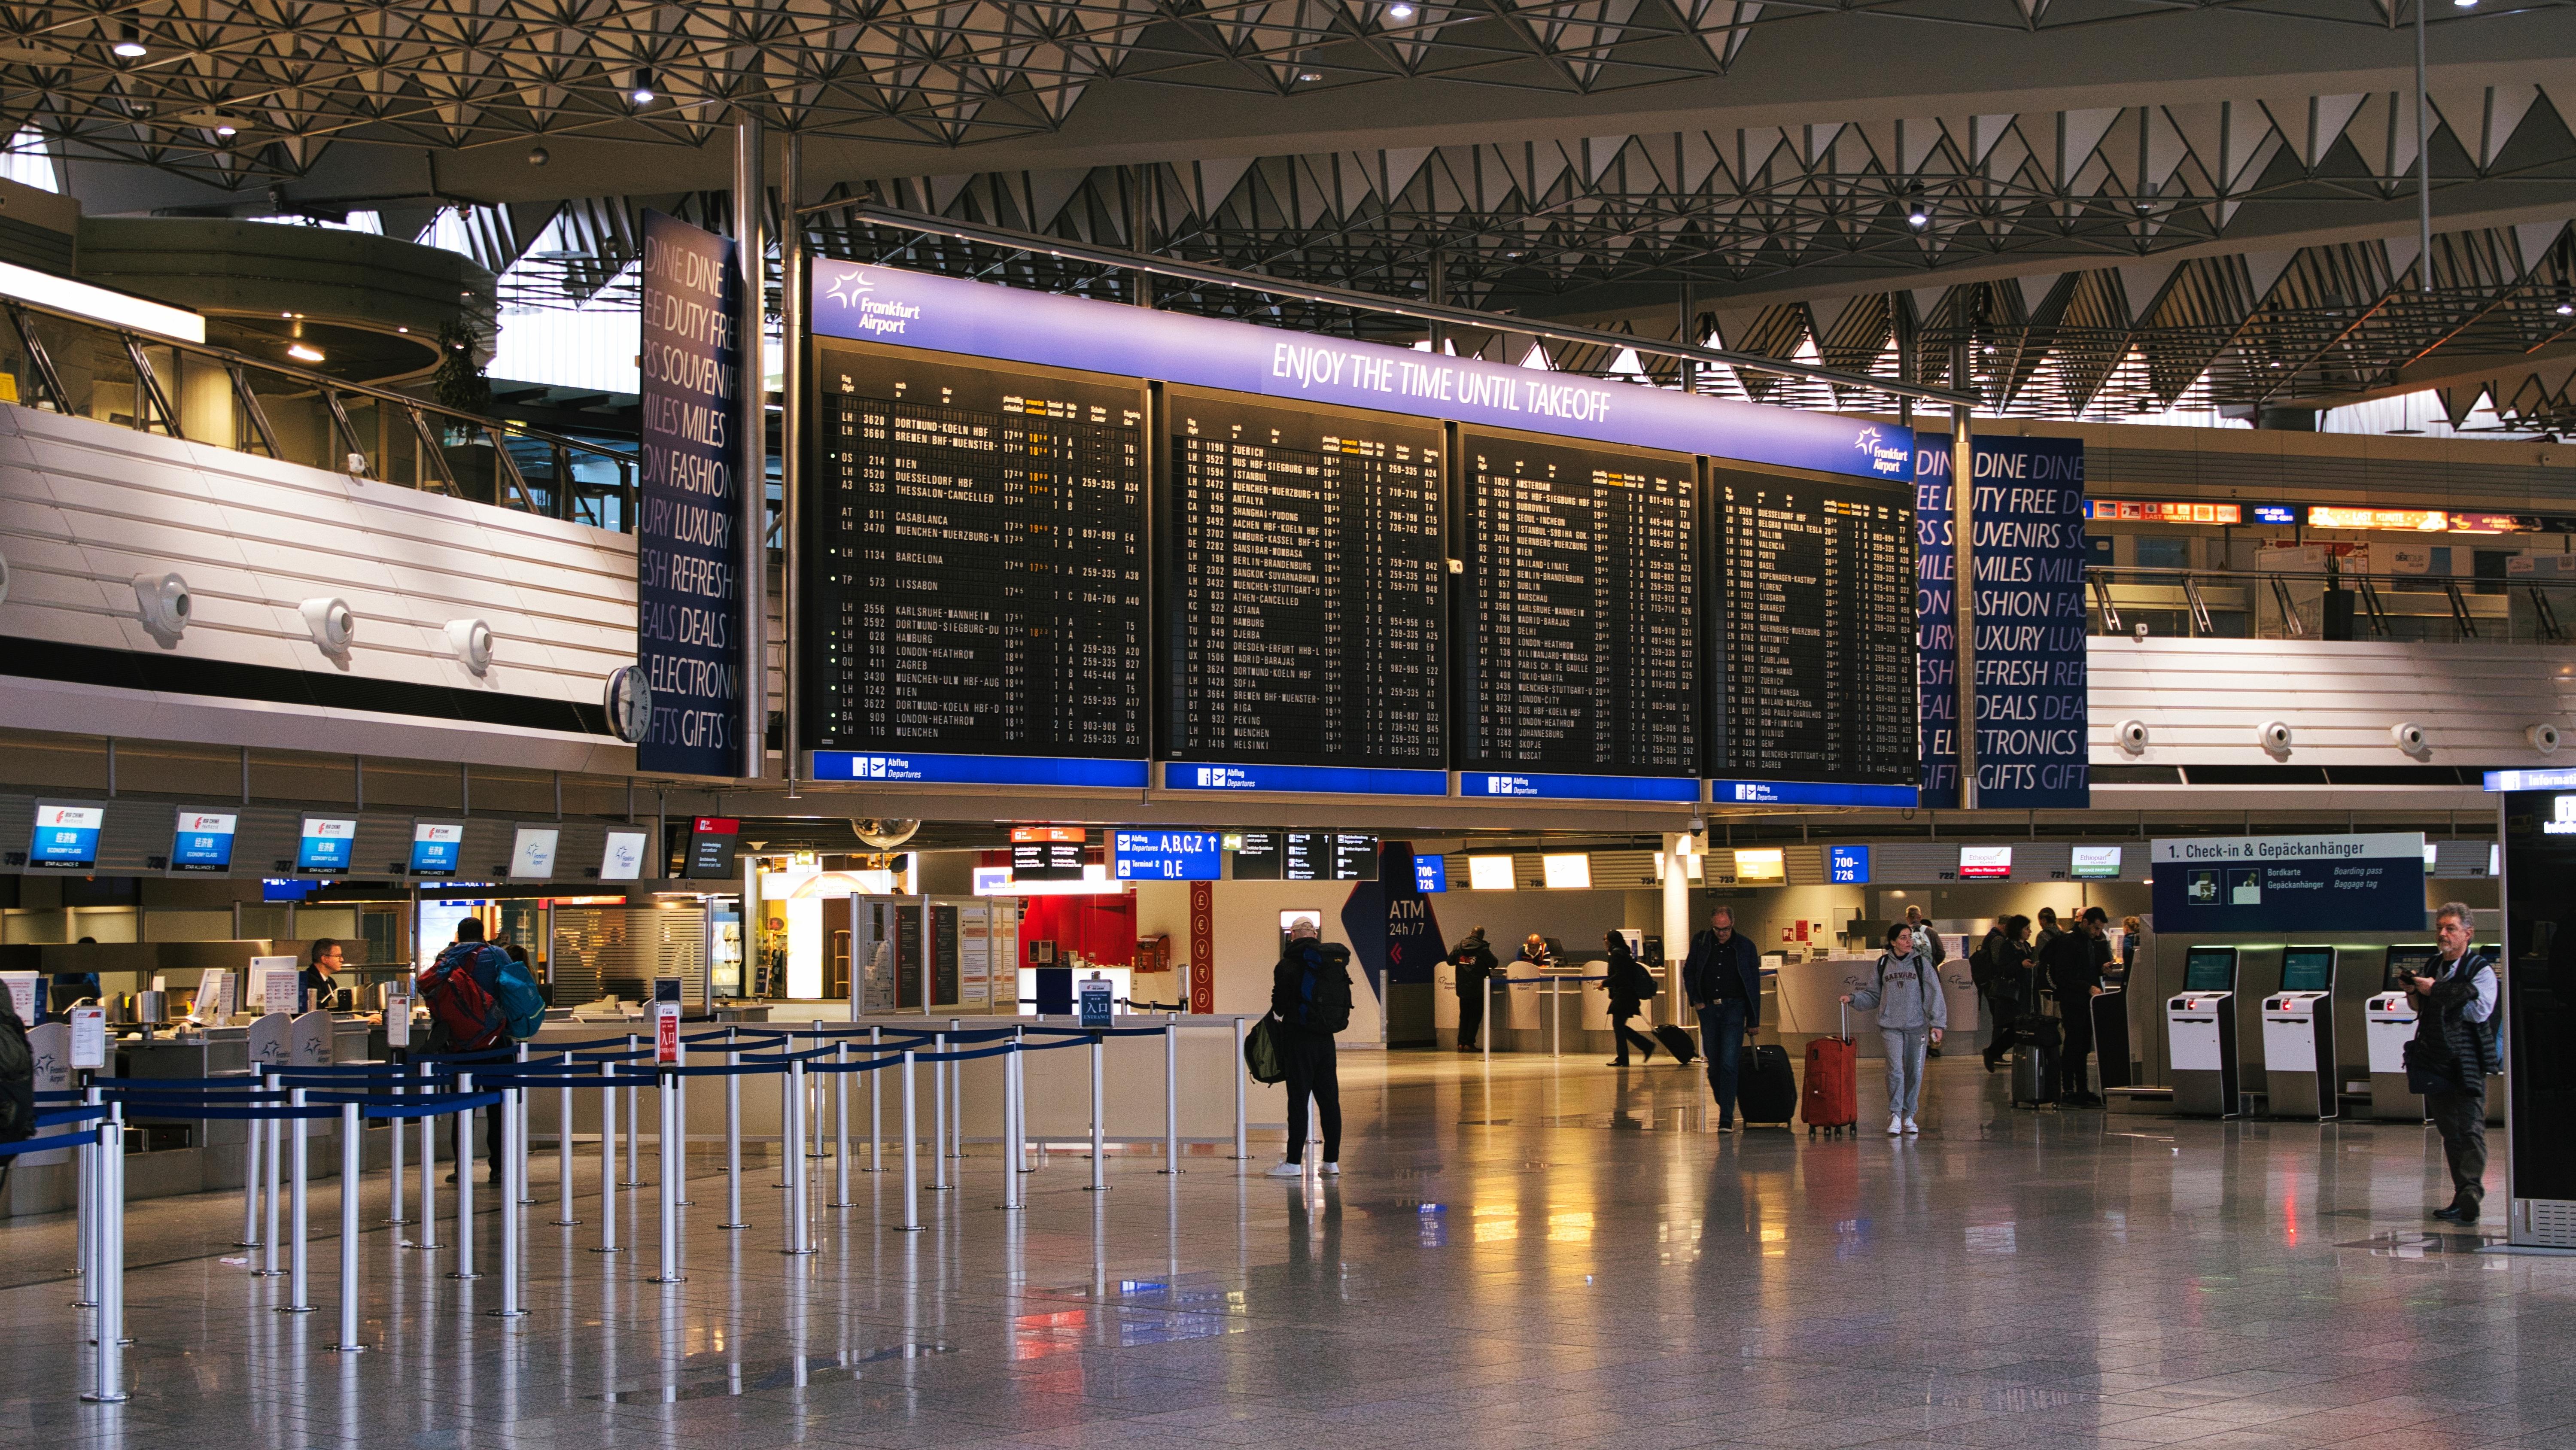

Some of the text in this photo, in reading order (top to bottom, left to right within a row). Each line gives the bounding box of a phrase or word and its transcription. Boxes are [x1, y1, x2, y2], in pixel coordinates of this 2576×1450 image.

[646, 236, 724, 298] DINE DINE
[861, 297, 920, 319] Frankfurt
[665, 295, 709, 341] DUTY
[859, 313, 905, 334] Airport
[1273, 344, 1611, 422] ENJOY THE TIME UNTIL TAKEOFF
[682, 403, 726, 448] MILES
[842, 412, 988, 437] LH 3620 DORTMUND-KOELN HBF
[1188, 440, 1264, 457] LH 1198 ZUERICH
[1874, 446, 1908, 461] Frankfurt
[1873, 458, 1900, 474] Airport
[1974, 453, 2028, 478] DINE
[670, 450, 734, 500] FASHION
[842, 466, 973, 488] LH 3520 DUESSELDORF HBF
[1234, 470, 1268, 482] ISTANBUL
[1232, 495, 1264, 506] ANTALYA
[2010, 489, 2057, 514] FREE
[1188, 502, 1298, 522] CA 936 SHANGHAI-PUDONG
[1516, 502, 1550, 514] DUBROVNIK
[842, 507, 948, 525] AT 811 CASABLANCA
[1516, 514, 1565, 526] SEOUL-INCHEON
[2353, 512, 2371, 521] LAST
[675, 503, 732, 549] LUXURY
[1758, 541, 1785, 550] VALENCIA
[842, 548, 1139, 581] LH 1134 BARCELONA 259-335 A38
[1233, 556, 1311, 571] BERLIN-BRANDENBURG
[672, 554, 733, 600] REFRESH
[842, 575, 937, 590] TP 573 LISSABON
[1517, 581, 1540, 591] DUBLIN
[679, 607, 726, 648] DEALS
[1518, 626, 1536, 635] DELHI
[842, 657, 927, 670] OU 411 ZAGREB
[1518, 672, 1563, 682] TOKIO-NARITA
[1234, 703, 1251, 712] RIGA
[682, 709, 724, 749] GIFTS
[1519, 729, 1563, 739] JOHANNESBURG
[1234, 740, 1268, 749] HELSINKI
[888, 758, 908, 768] Abflug
[888, 769, 921, 779] Departures
[1227, 769, 1244, 778] Abflug
[1978, 764, 2036, 790] GIFTS
[1227, 779, 1255, 788] Departures
[1513, 777, 1528, 786] Abflug
[1513, 787, 1537, 795] Departures
[1131, 835, 1148, 843] Abflug
[2169, 842, 2364, 859] 1. Check-in & Gepäckanhänger
[1835, 857, 1859, 867] 700-
[1164, 860, 1183, 878] D,E
[1417, 866, 1436, 876] 700-
[1835, 870, 1853, 880] 726
[2268, 868, 2301, 876] Bordkarte
[2334, 867, 2364, 876] Boarding
[1419, 880, 1434, 890] 726
[2268, 880, 2378, 890] Gepäckanhänger Baggage tag
[1389, 900, 1424, 918] ATM
[1390, 923, 1408, 935] 24h
[1418, 923, 1424, 934] 7
[1885, 972, 1917, 982] HARVARD
[1086, 1002, 1107, 1014] 入口
[661, 1031, 675, 1046] 入口
